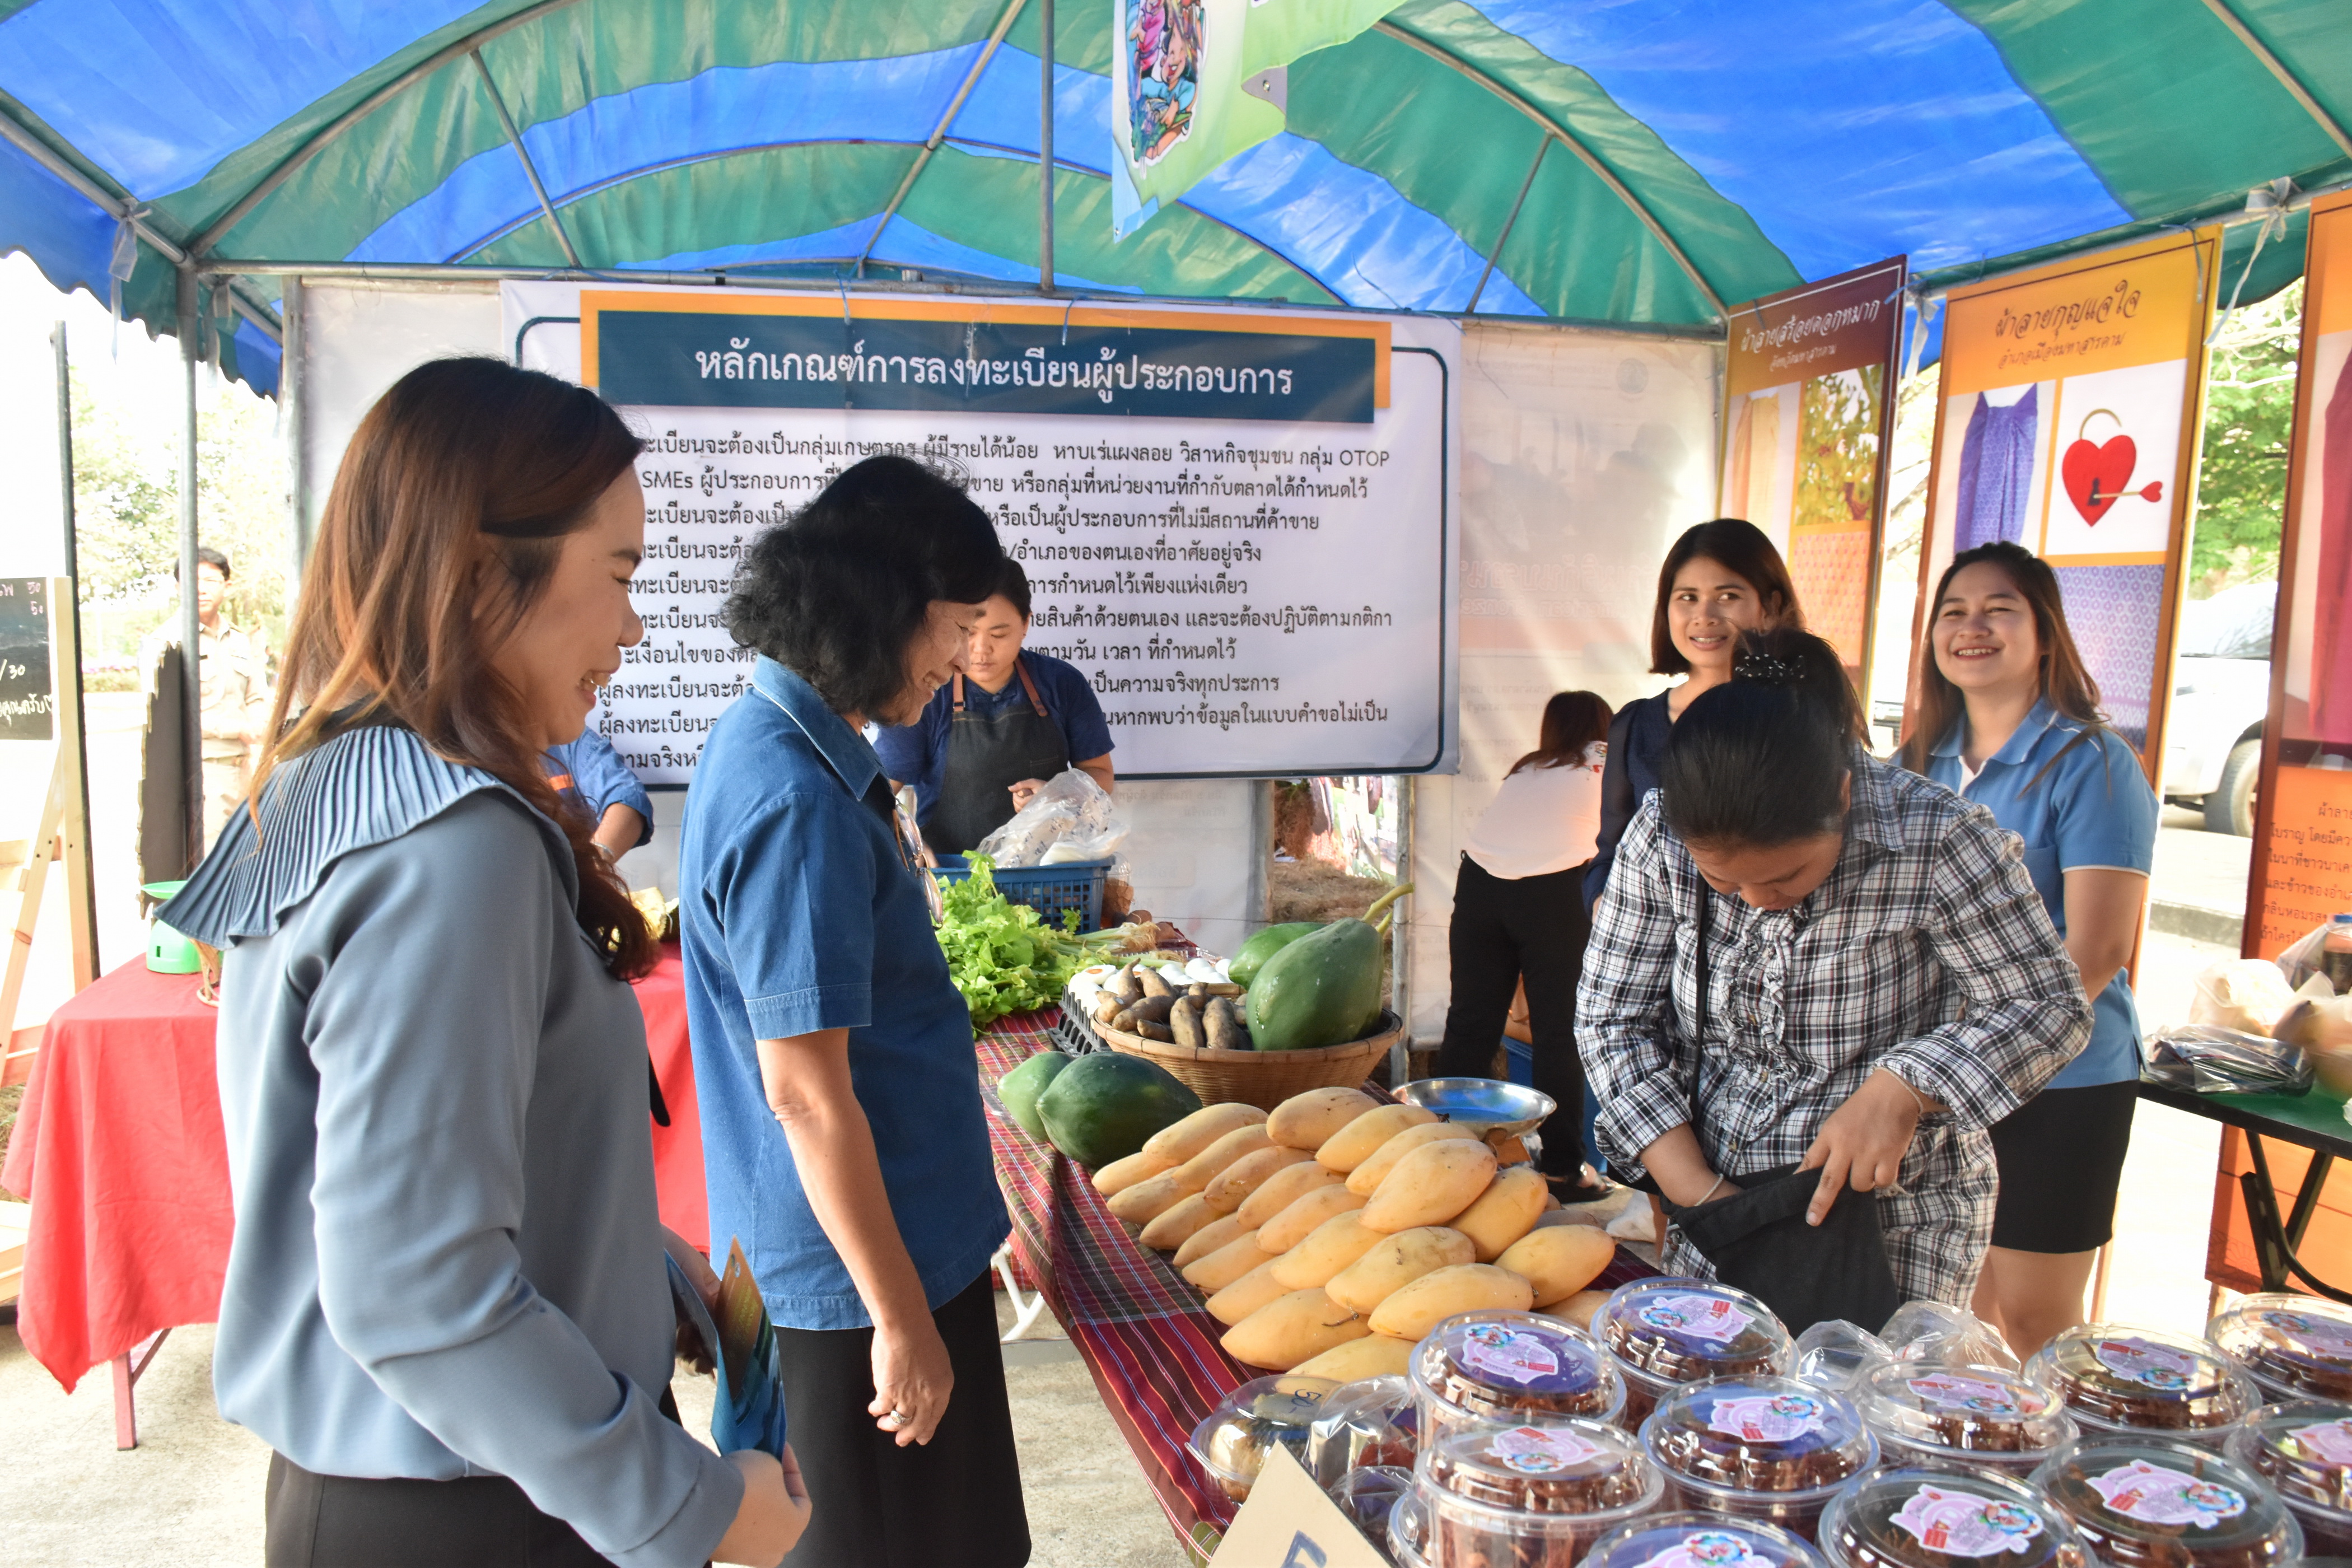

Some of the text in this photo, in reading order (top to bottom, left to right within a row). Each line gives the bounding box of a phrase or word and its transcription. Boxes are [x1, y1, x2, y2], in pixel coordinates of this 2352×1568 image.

[696, 337, 1293, 403] หลักเกณฑ์การลงทะเบียนผู้ประกอบการ
[1053, 440, 1172, 462] หาบเร่แผงลอย
[1180, 440, 1294, 472] วิสาหกิจชุมชน
[1299, 445, 1333, 473] กลุ่ม
[1339, 450, 1390, 466] OTOP
[642, 471, 693, 488] SMEs
[1186, 605, 1392, 633] และจะต้องปฏิบัติตามกติกา
[1103, 645, 1141, 660] เวลา
[1147, 633, 1236, 660] ที่กำหนดไว้
